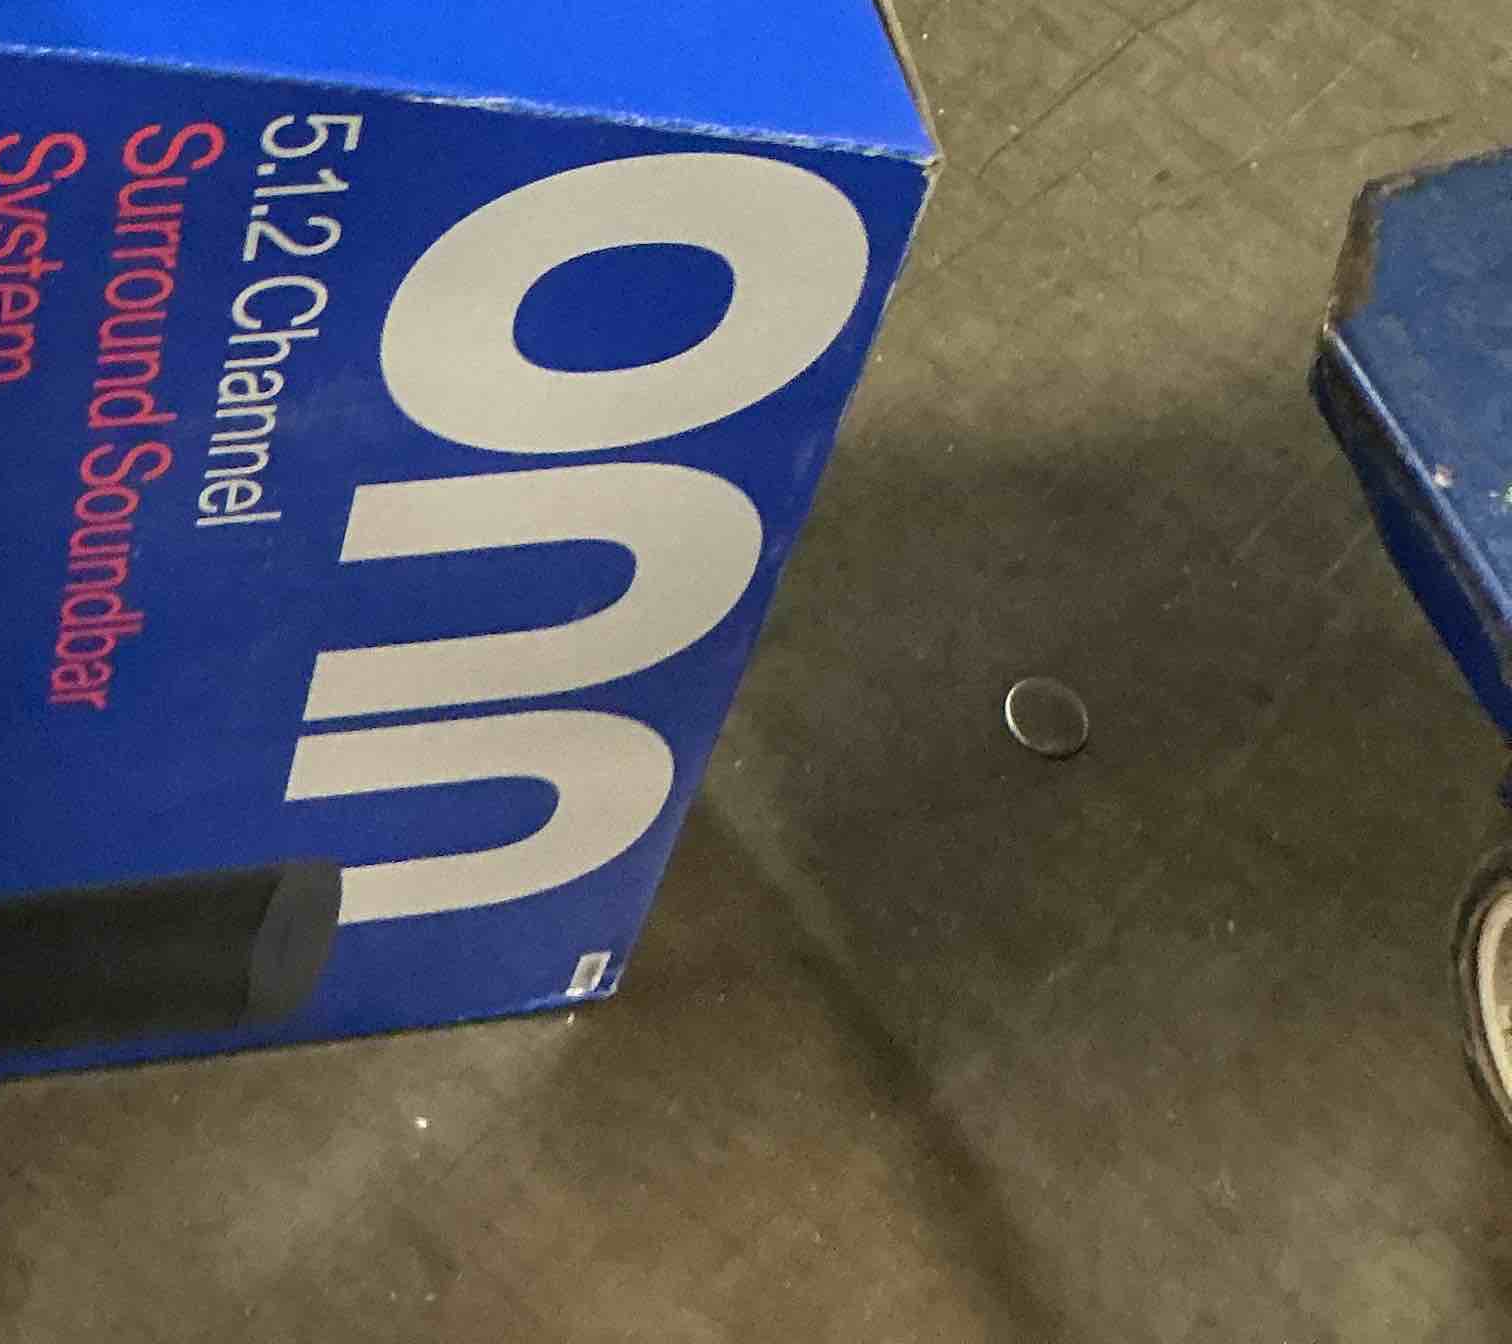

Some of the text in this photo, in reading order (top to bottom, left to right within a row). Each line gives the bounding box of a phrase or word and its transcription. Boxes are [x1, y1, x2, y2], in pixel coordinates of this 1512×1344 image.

[50, 122, 226, 710] Surround Soundbar
[196, 114, 364, 528] 5.1.2 Channel
[284, 152, 870, 925] onn
